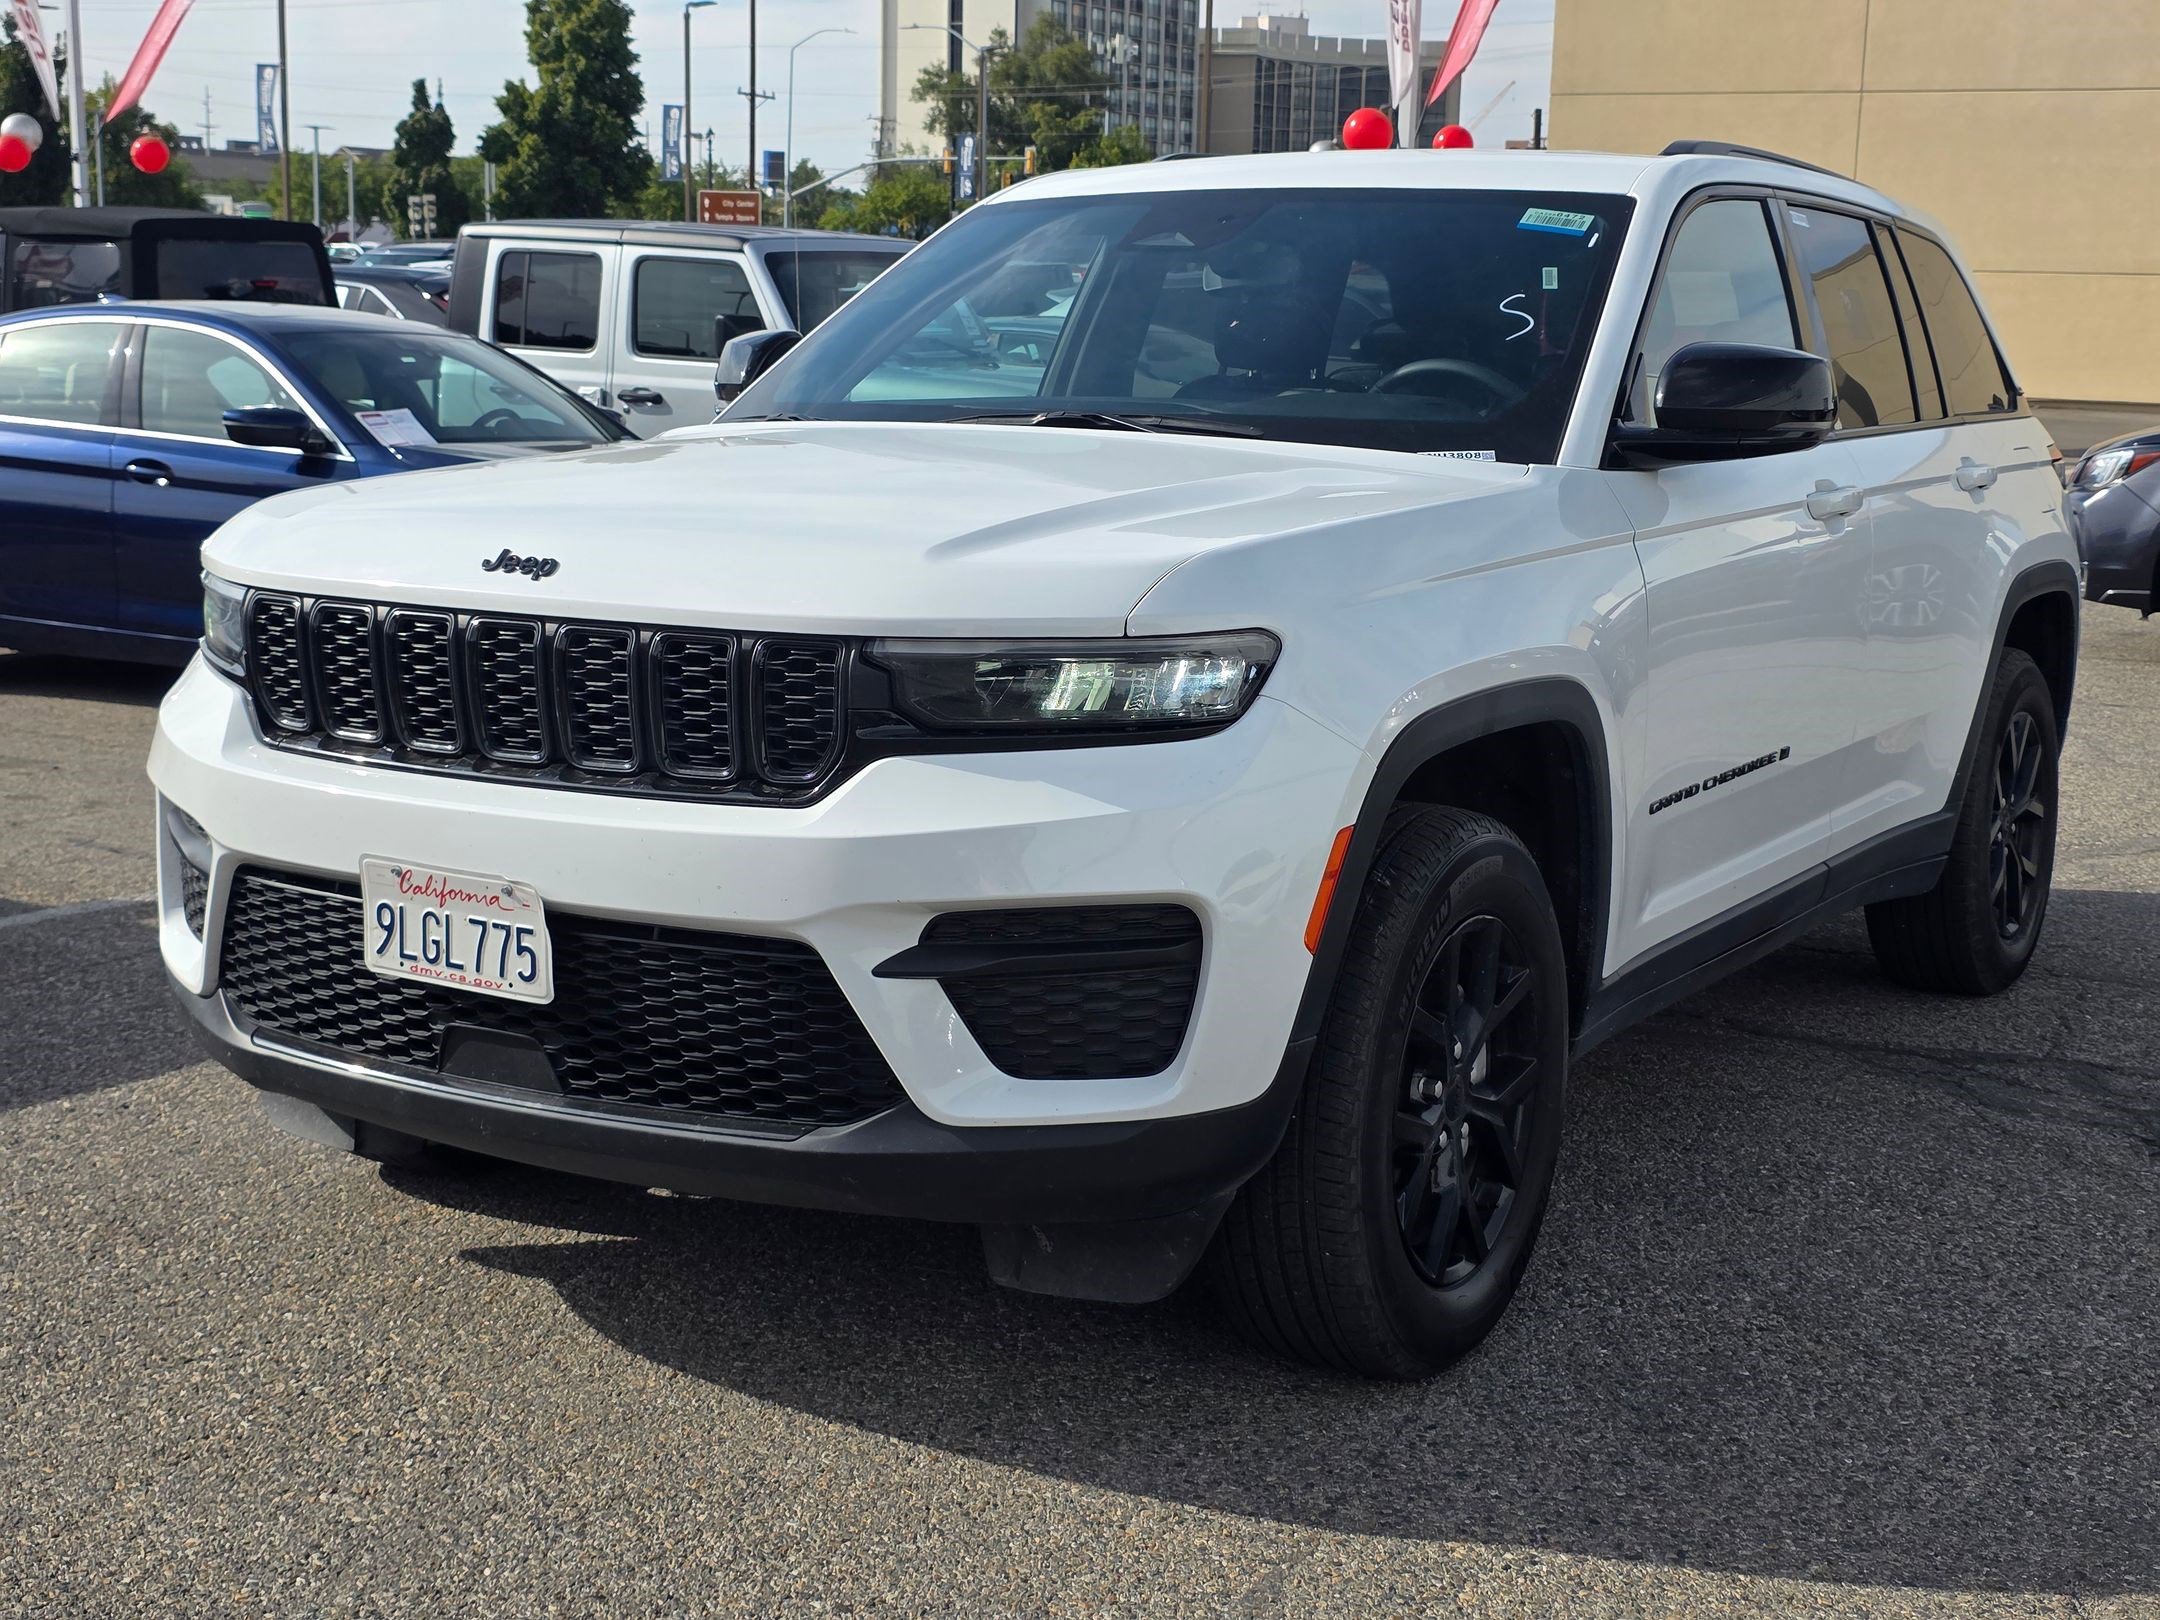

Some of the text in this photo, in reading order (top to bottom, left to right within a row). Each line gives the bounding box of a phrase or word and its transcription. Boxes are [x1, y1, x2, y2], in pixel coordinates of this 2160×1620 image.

[482, 548, 560, 582] Jeep
[1649, 751, 1778, 815] GRAND CHEROKEE
[400, 869, 514, 912] California
[376, 901, 537, 983] 9LGL775
[410, 964, 504, 989] dmv.ca.gov
